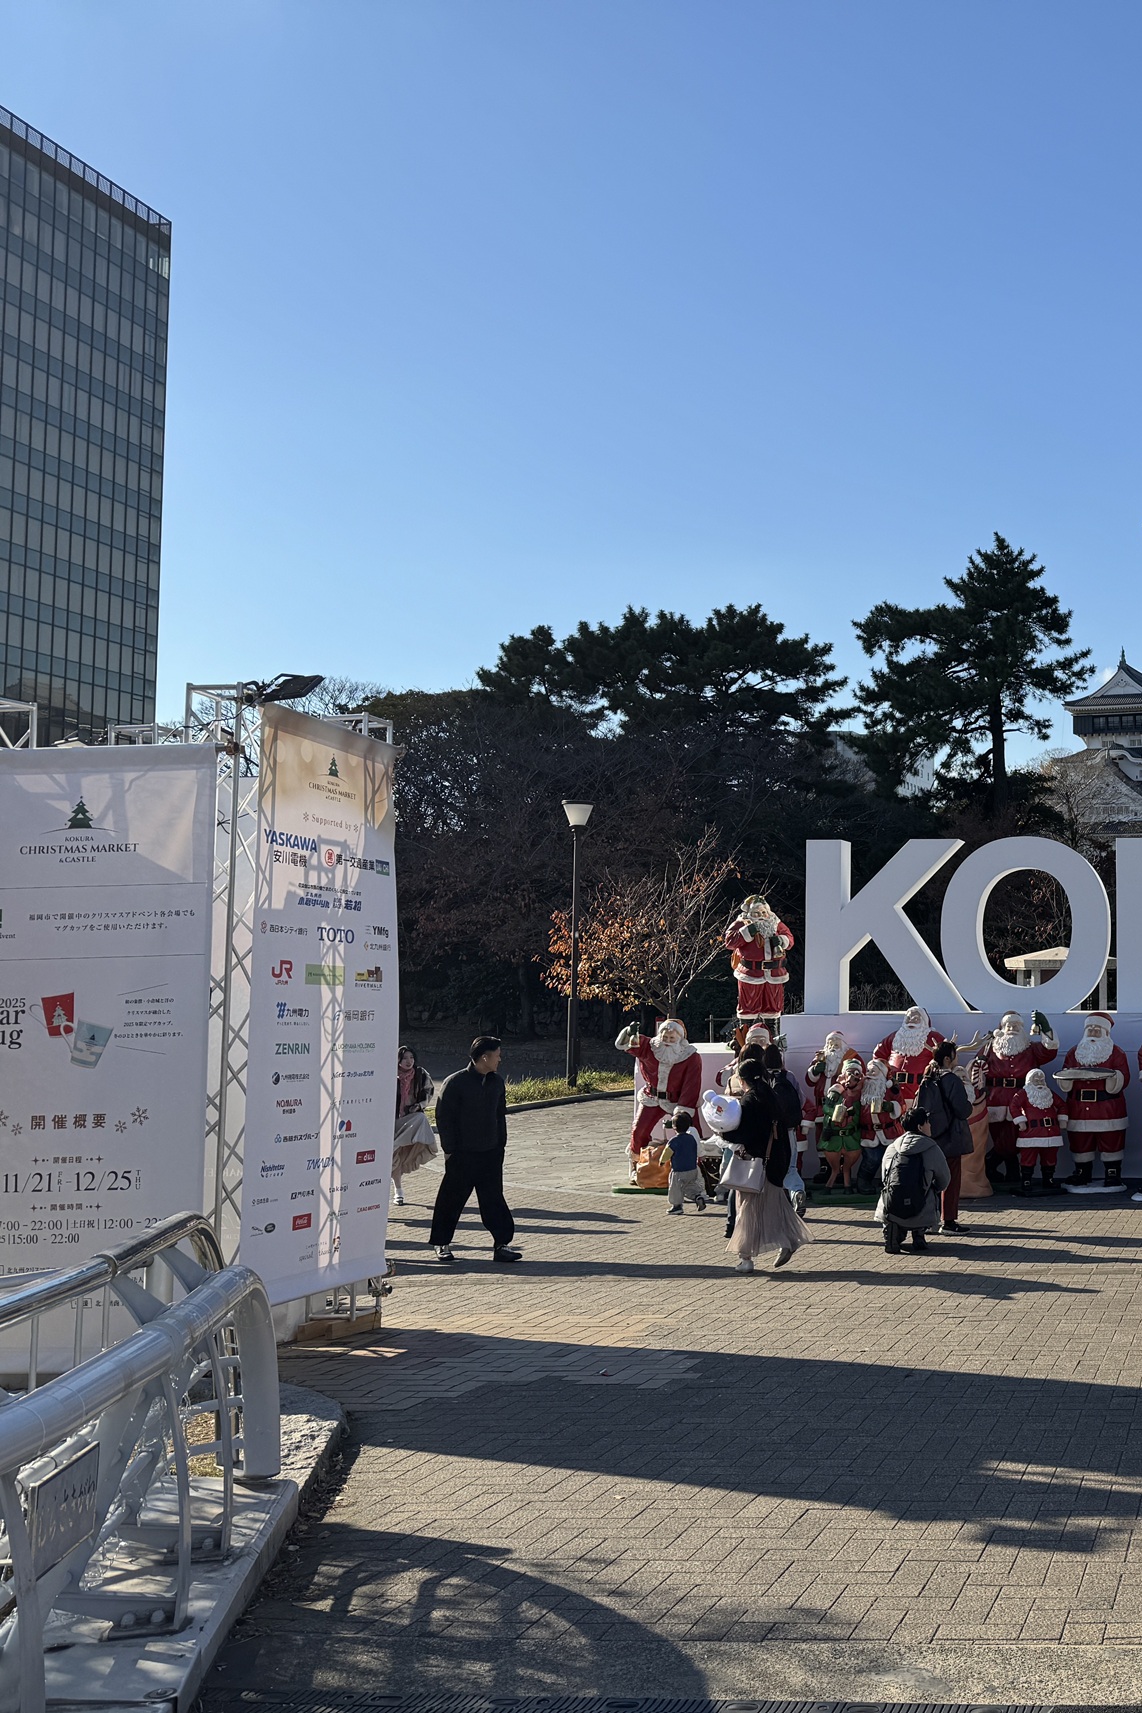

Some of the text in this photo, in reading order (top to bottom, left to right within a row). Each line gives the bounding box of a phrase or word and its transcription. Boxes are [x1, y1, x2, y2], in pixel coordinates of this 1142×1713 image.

[308, 781, 357, 800] CHRISTMAS MARKET
[311, 813, 352, 831] Supported by
[263, 828, 318, 853] YASKAWA
[19, 842, 140, 855] CHRISTMAS MARKET
[273, 849, 308, 868] 安川電機
[335, 853, 375, 872] 第一交通産業
[344, 899, 362, 911] 若松
[269, 924, 308, 936] 西日本シティ銀行
[316, 926, 355, 944] TOTO
[372, 925, 389, 938] YMfg
[271, 959, 293, 979] JR
[0, 997, 26, 1008] 2025
[285, 1007, 310, 1018] 九州電力
[344, 1010, 375, 1021] 福岡銀行
[275, 1043, 310, 1055] ZENRIN
[276, 1098, 302, 1108] NOMURA
[30, 1112, 107, 1131] 開催概要
[52, 1156, 83, 1164] 開催日程
[306, 1156, 335, 1170] TAKADA
[260, 1163, 285, 1173] Nishitetsu
[3, 1172, 53, 1194] 11/21
[74, 1169, 133, 1192] 12/25
[329, 1185, 348, 1193] takagi
[50, 1202, 83, 1211] 開催時間
[31, 1219, 62, 1231] 22:00
[70, 1219, 96, 1230] 土日祝
[103, 1217, 133, 1230] 12:00
[144, 1216, 168, 1229] 22:
[12, 1233, 38, 1245] 15:00
[51, 1233, 80, 1244] 22:00
